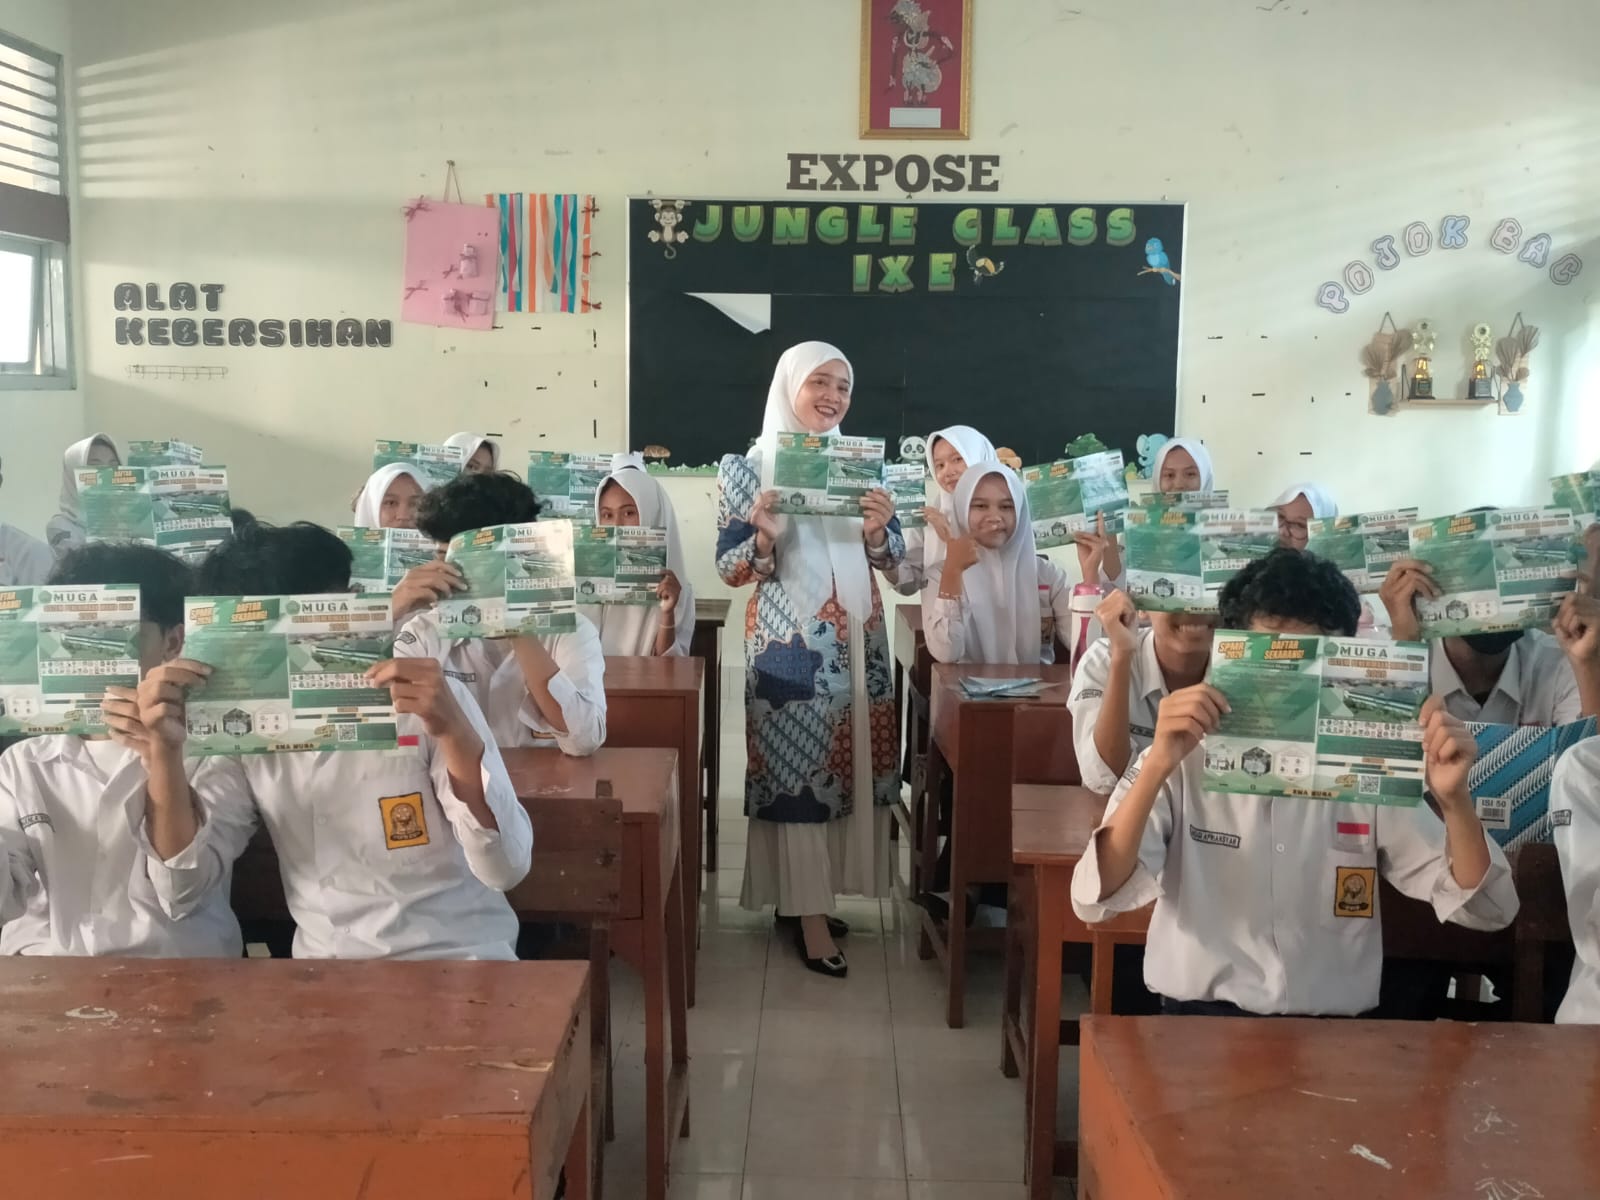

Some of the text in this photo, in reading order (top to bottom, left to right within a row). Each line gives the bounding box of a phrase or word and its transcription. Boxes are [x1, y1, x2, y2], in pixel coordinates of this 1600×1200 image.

[786, 153, 1000, 193] EXPOSE
[693, 204, 1136, 246] JUNGLE CLASS
[1317, 214, 1470, 314] POJOK
[114, 281, 225, 312] ALAT
[115, 316, 392, 348] KEBERSIHAN
[160, 469, 197, 478] MUGA
[1503, 511, 1540, 522] MUGA
[53, 592, 99, 602] MUGA
[301, 601, 350, 613] MUGA
[1340, 646, 1388, 659] MUGA
[1481, 799, 1507, 808] ISI 50
